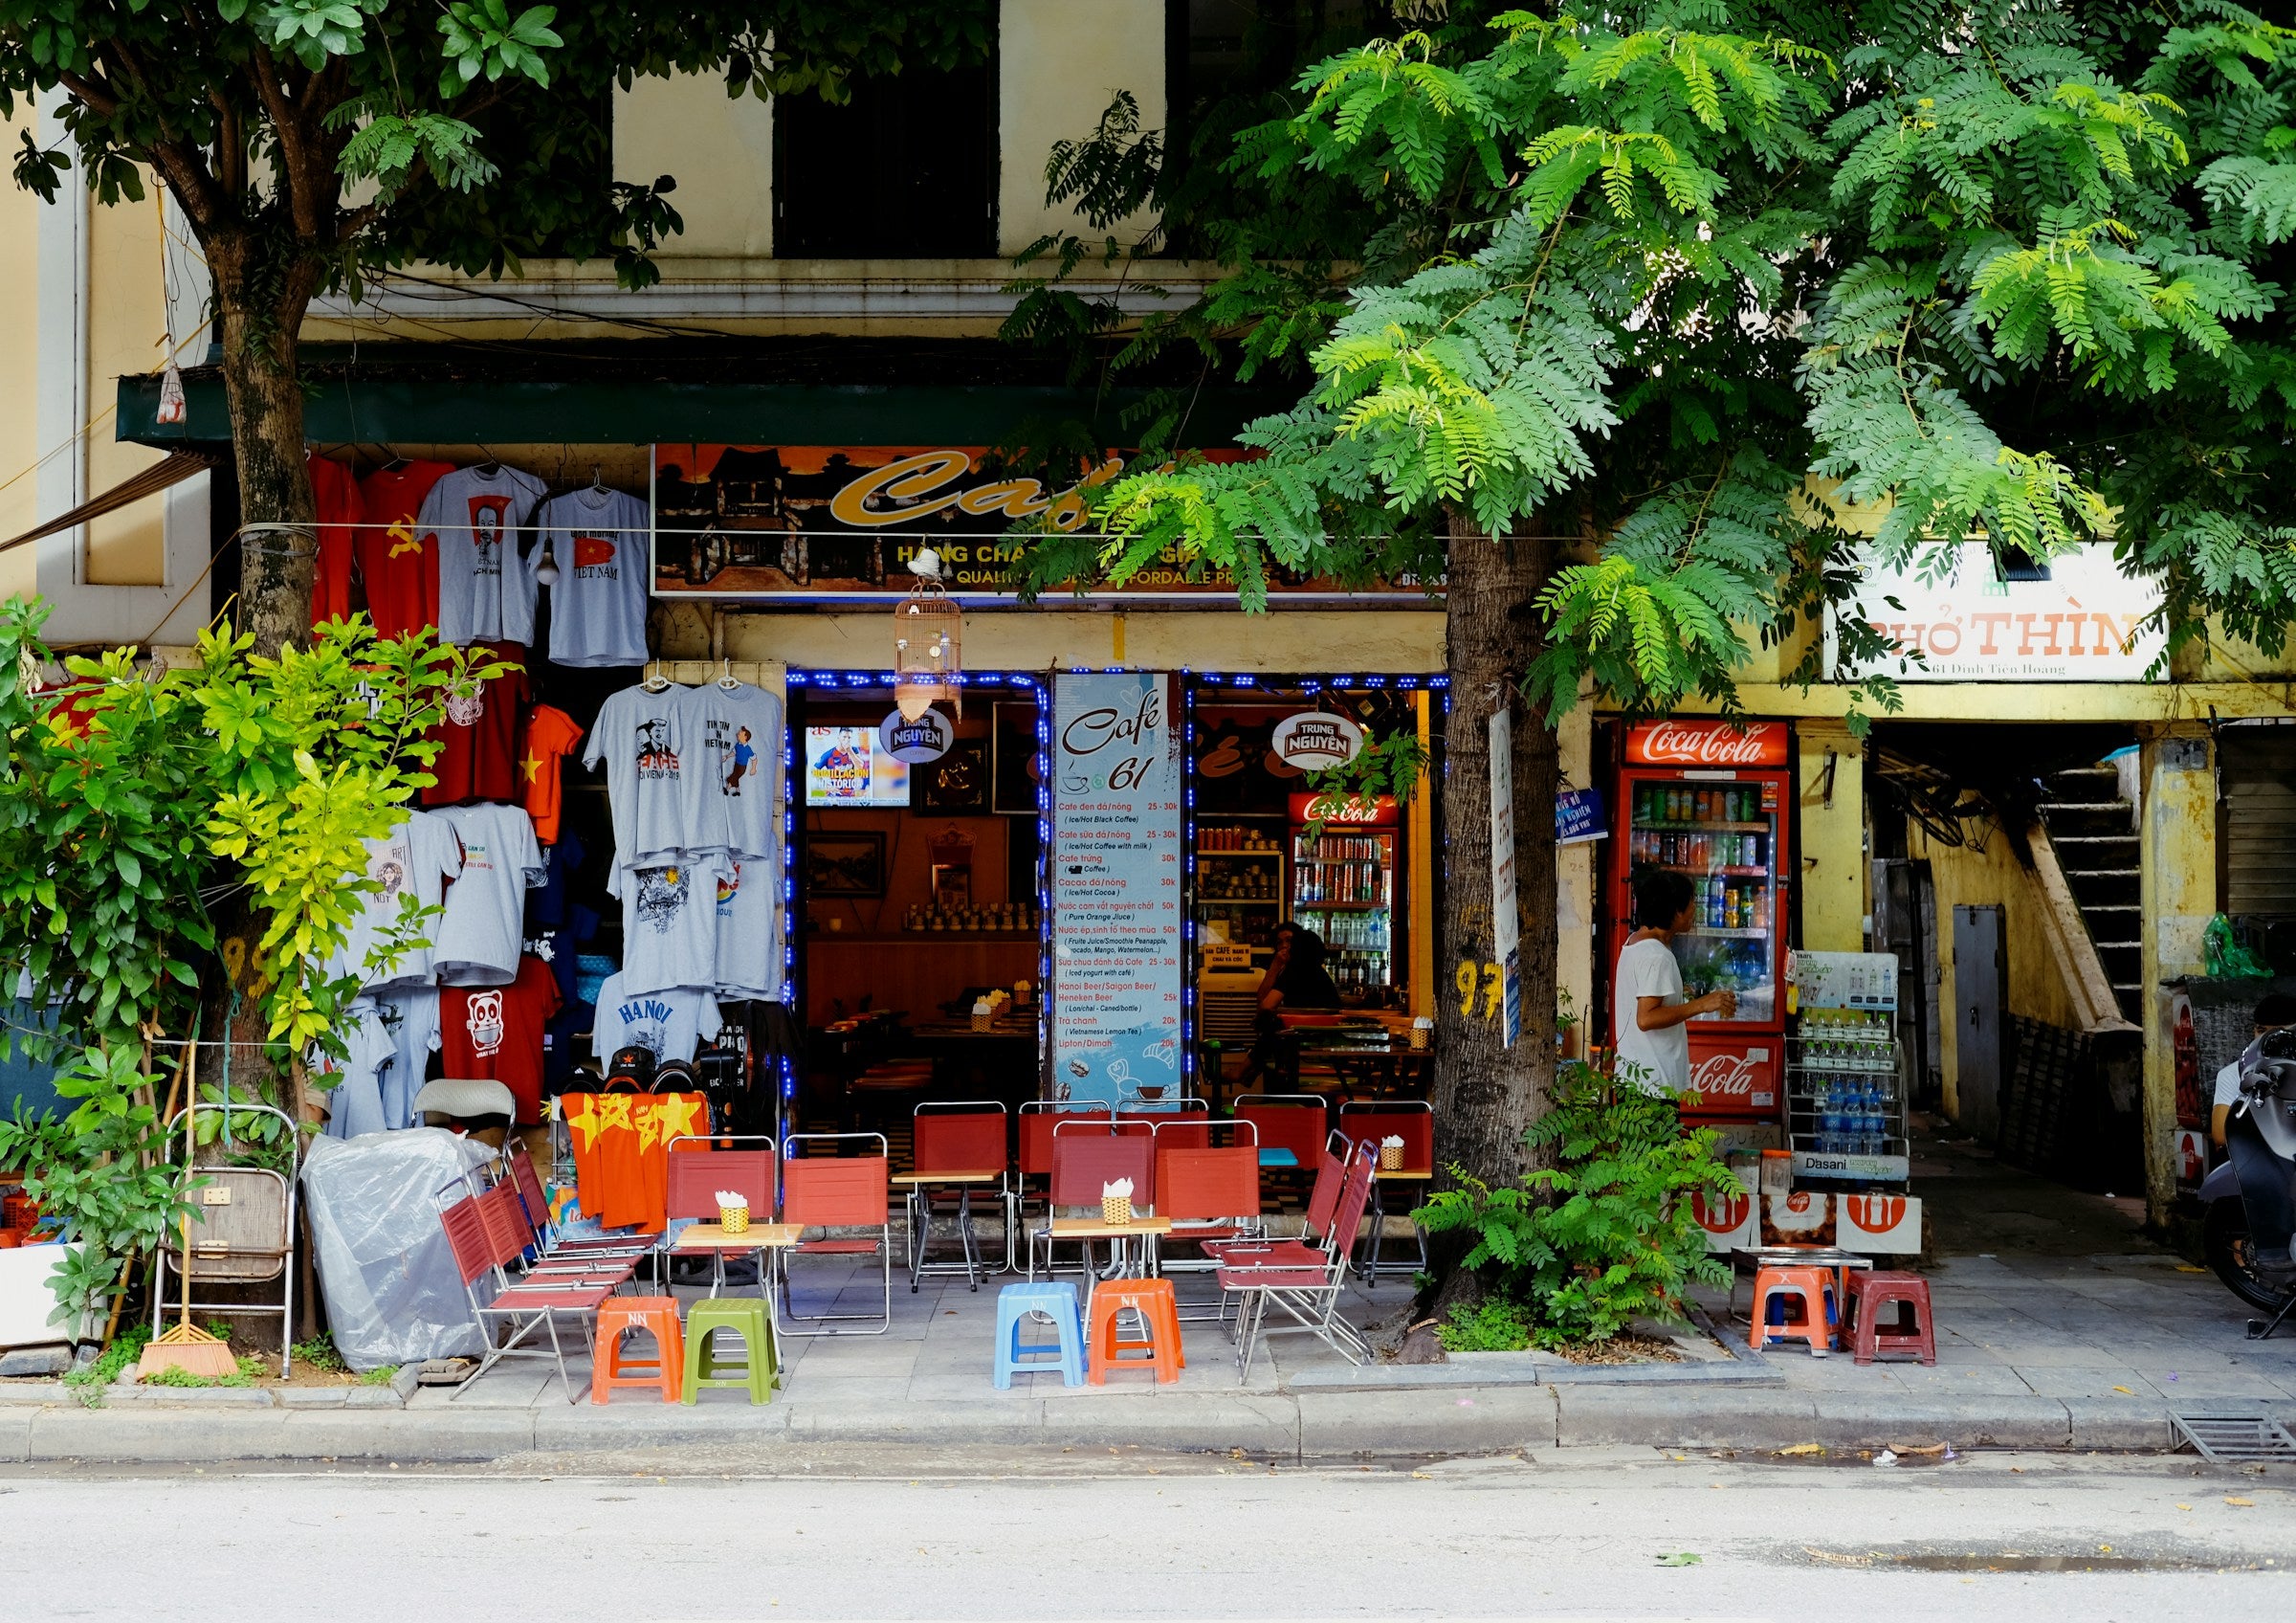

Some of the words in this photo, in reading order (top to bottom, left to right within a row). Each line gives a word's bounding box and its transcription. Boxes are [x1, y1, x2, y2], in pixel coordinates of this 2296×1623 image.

[597, 567, 618, 580] NAM
[1970, 595, 2141, 656] THÌN
[1932, 663, 1946, 674] 61
[1300, 723, 1335, 735] TRUNG
[894, 728, 940, 745] NGUYÊN
[1643, 722, 1769, 763] Coca-Cola
[1289, 735, 1347, 753] NGUYÊN
[638, 752, 680, 769] EACE
[1108, 756, 1155, 792] 61
[1147, 802, 1158, 811] 25
[1163, 802, 1178, 811] 30k
[1161, 901, 1175, 910] 50k
[1119, 925, 1137, 934] theo
[1162, 925, 1177, 934] 50k
[1058, 982, 1082, 990] Hanoi
[1058, 993, 1093, 1002] Heneken
[1094, 993, 1114, 1002] Beer
[618, 1000, 673, 1025] HANOI
[1072, 1016, 1097, 1025] chanh
[1162, 1016, 1177, 1025] 20k
[1160, 1039, 1175, 1048] 20k
[1805, 1157, 1847, 1170] Dasani
[1031, 1301, 1048, 1310] NN
[1120, 1295, 1139, 1308] NN
[628, 1312, 648, 1327] NN
